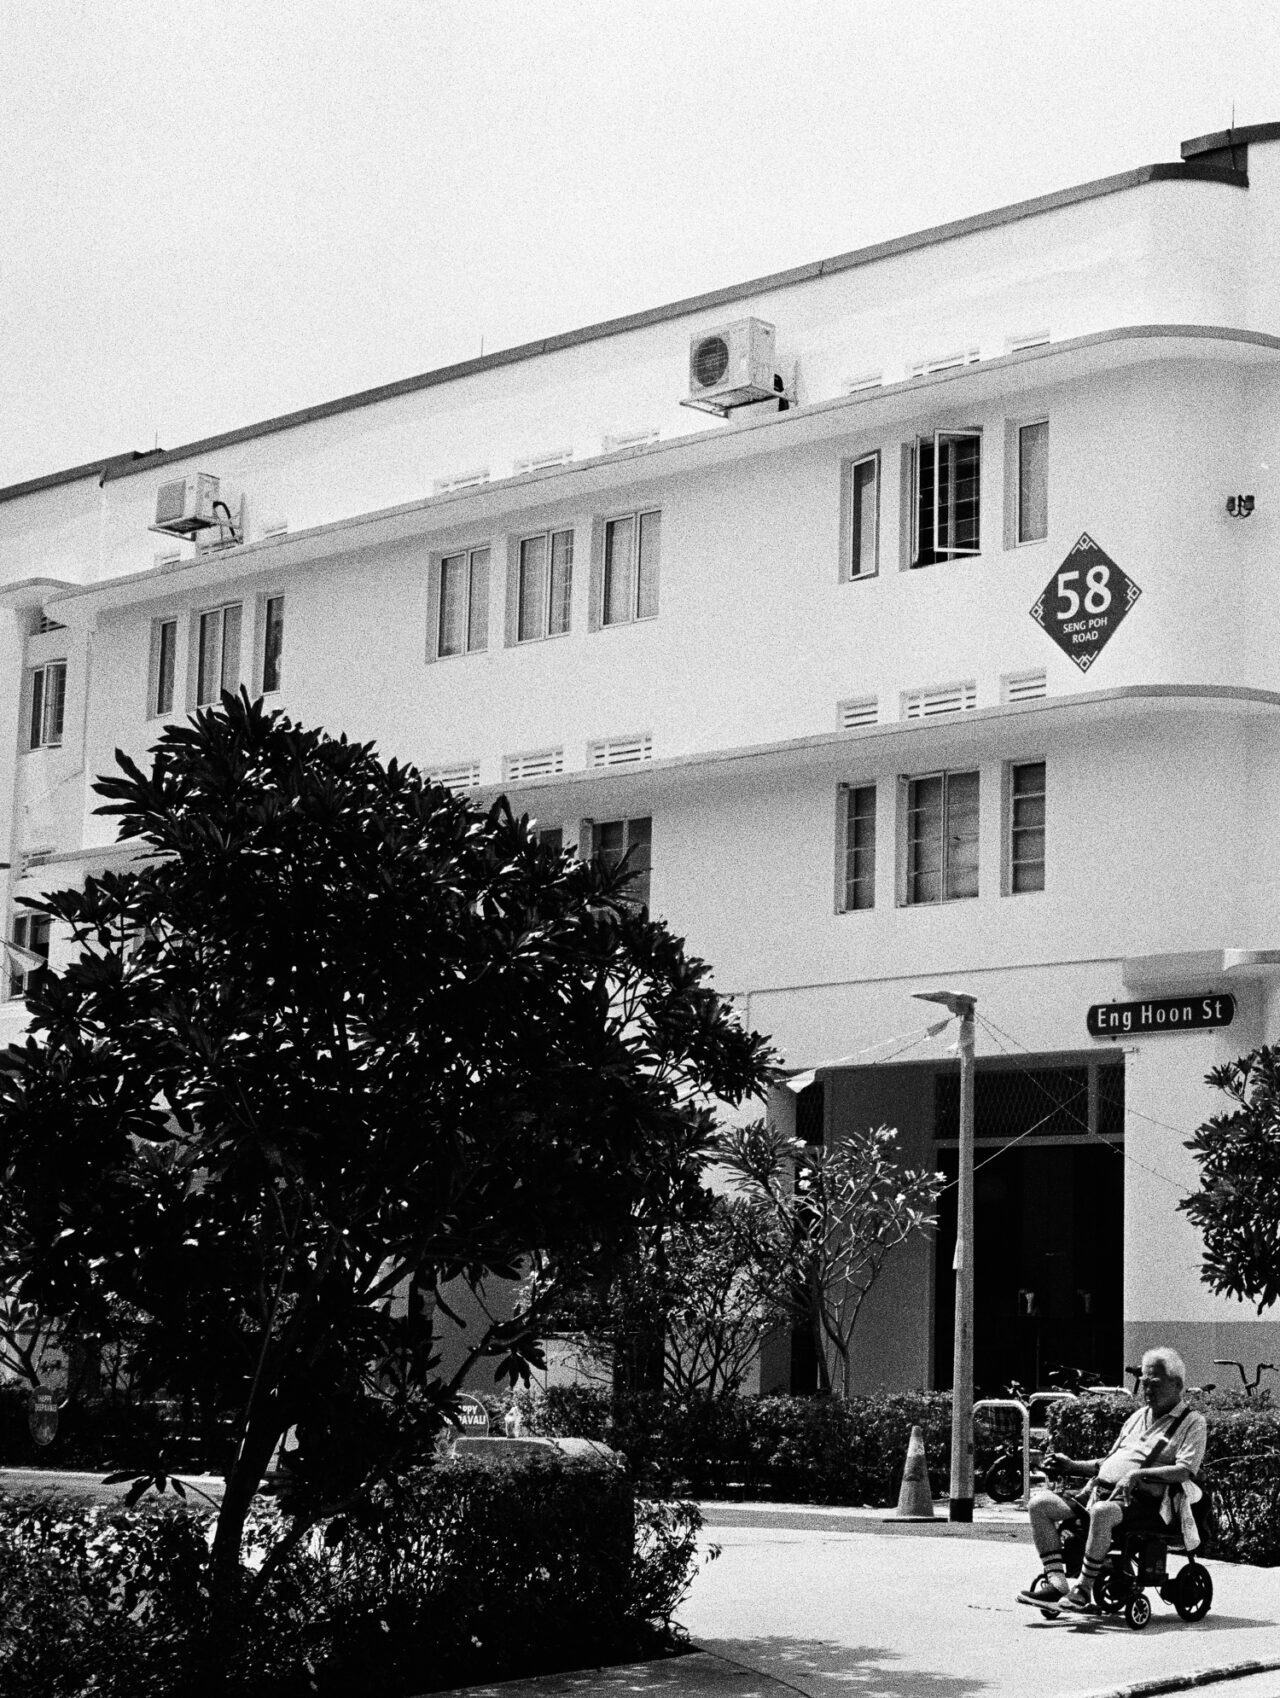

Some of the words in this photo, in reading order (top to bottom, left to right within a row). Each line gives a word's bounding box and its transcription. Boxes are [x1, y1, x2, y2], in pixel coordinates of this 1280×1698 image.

[1056, 565, 1112, 620] 58
[1062, 620, 1087, 634] SENG
[1088, 616, 1108, 631] POH
[1072, 630, 1099, 644] ROAD
[1097, 1007, 1132, 1031] Eng
[1141, 1004, 1192, 1024] Hoon
[1202, 999, 1222, 1020] St
